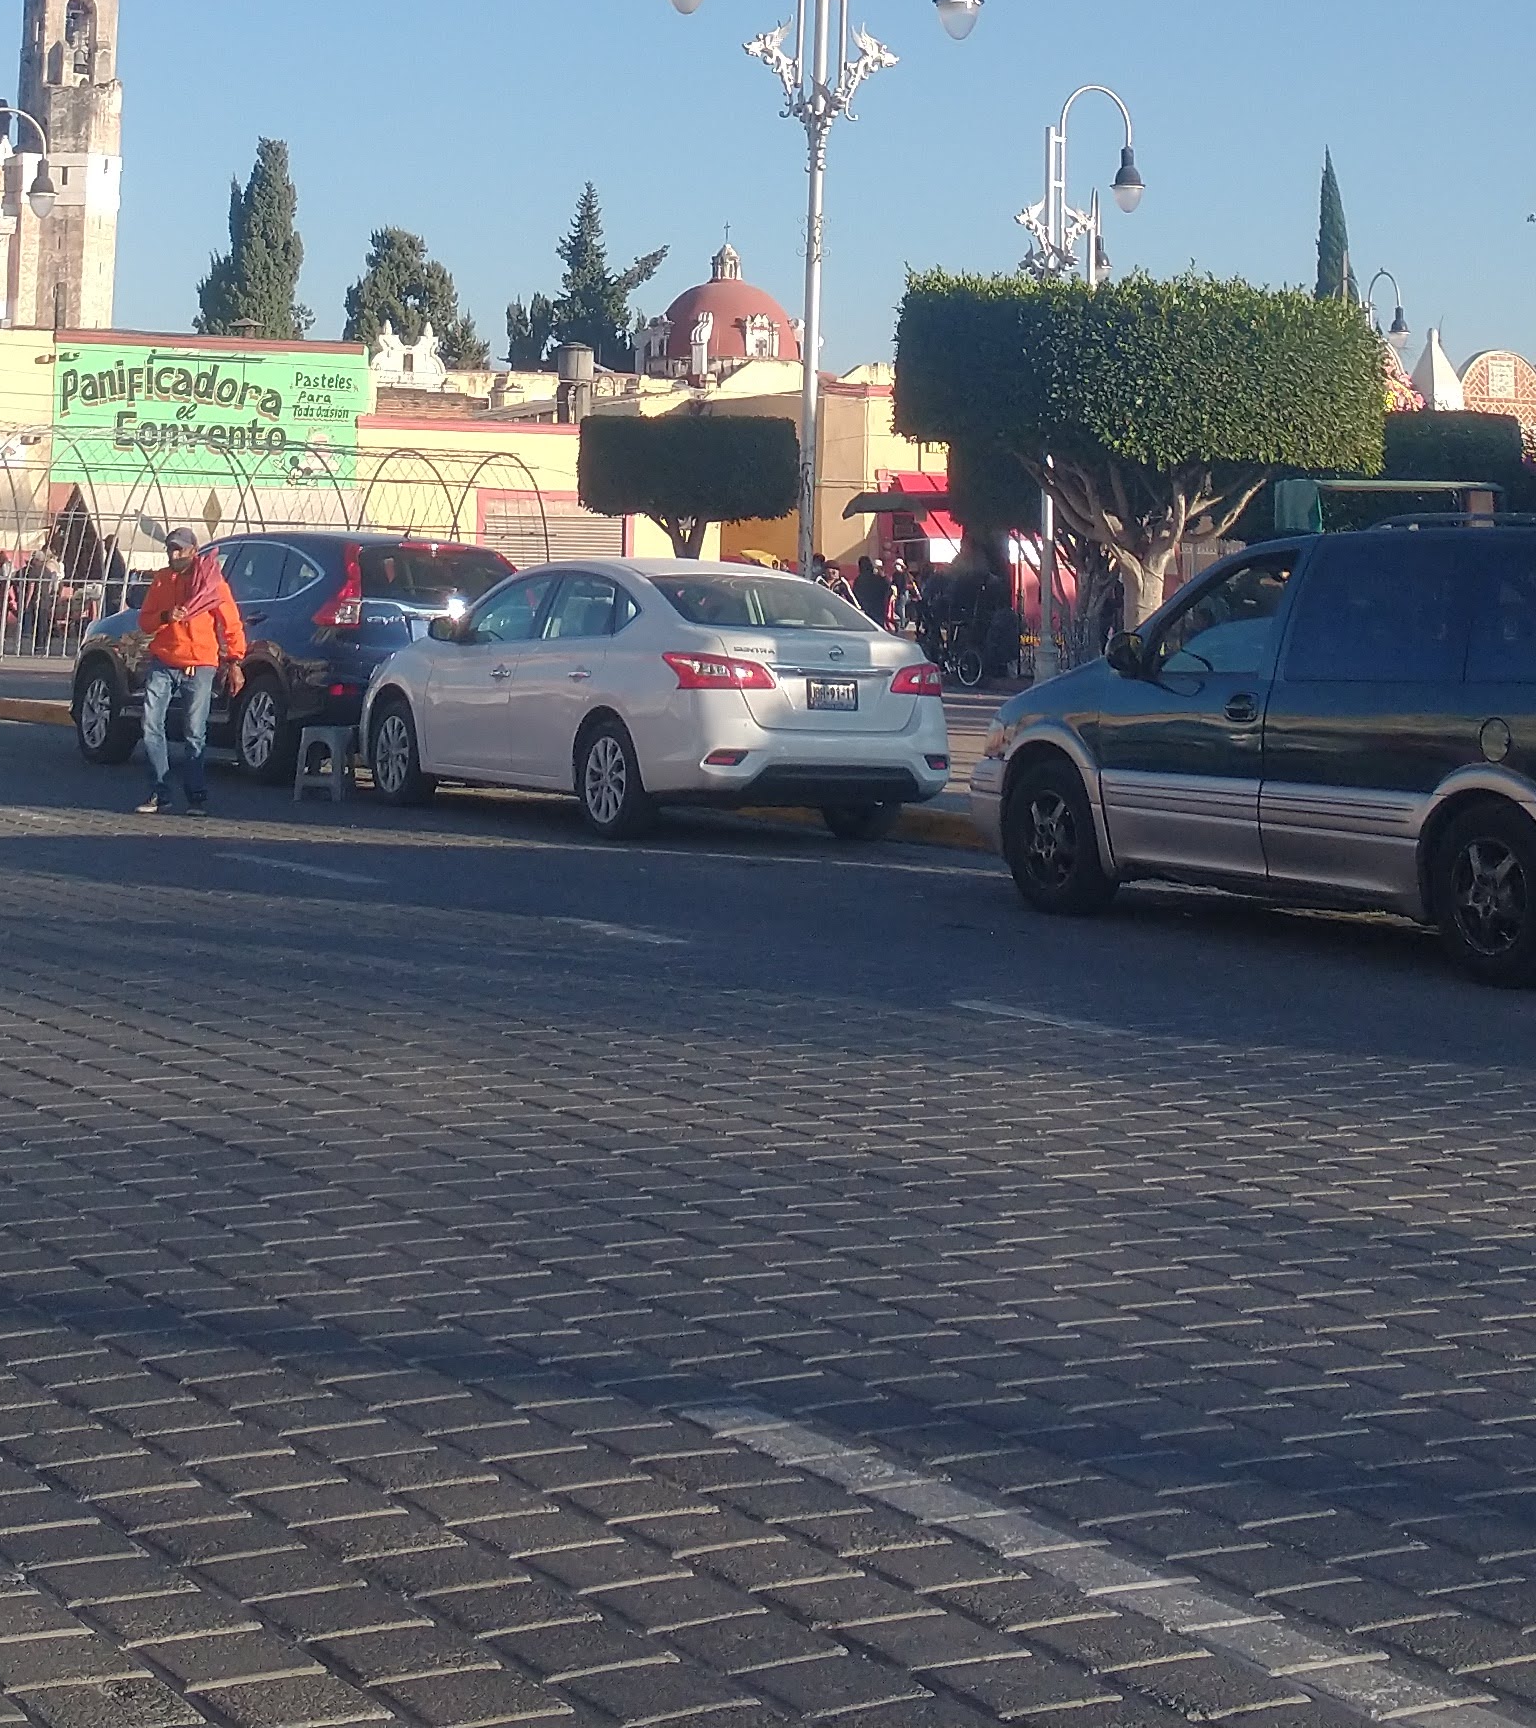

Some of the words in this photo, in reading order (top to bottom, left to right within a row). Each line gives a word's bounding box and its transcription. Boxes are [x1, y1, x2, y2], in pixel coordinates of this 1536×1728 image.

[60, 358, 283, 422] Panificadora
[295, 371, 353, 390] Pasteles
[297, 390, 332, 403] Para
